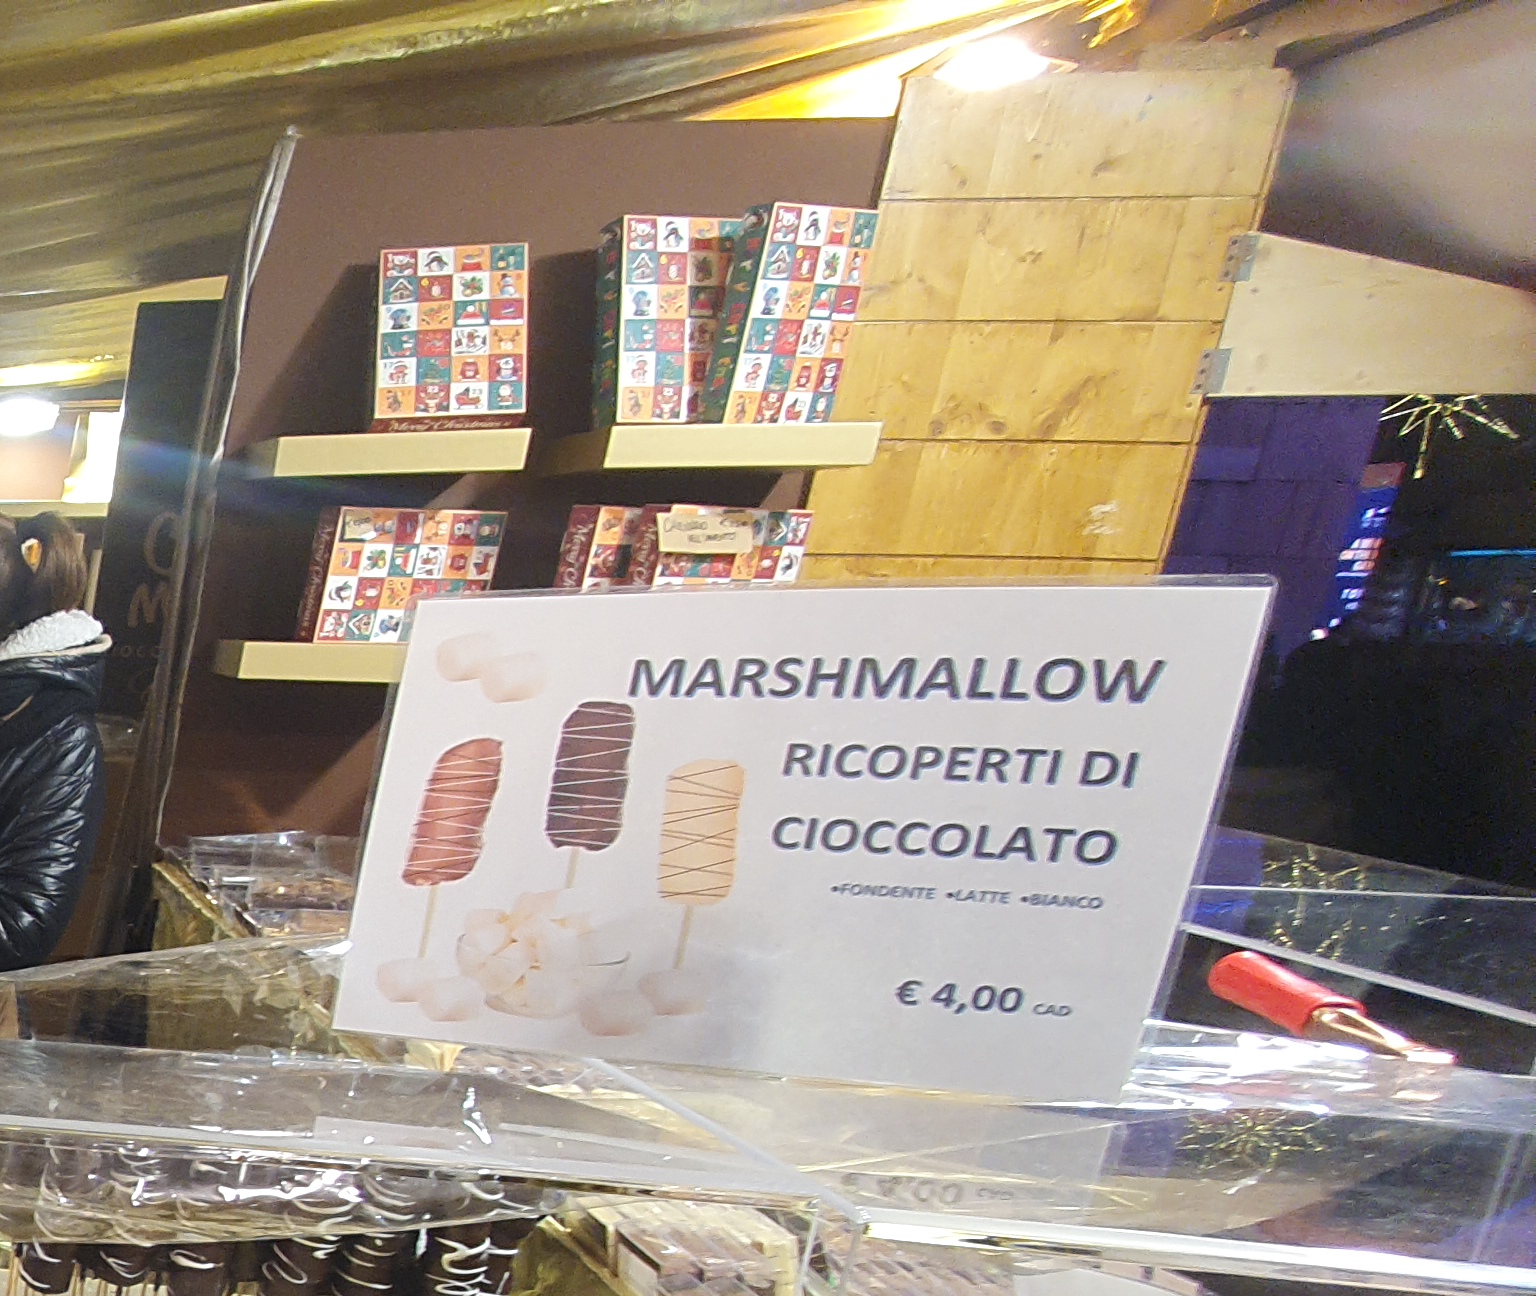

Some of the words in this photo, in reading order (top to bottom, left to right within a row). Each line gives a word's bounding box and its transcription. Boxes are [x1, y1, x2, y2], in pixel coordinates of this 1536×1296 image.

[628, 656, 1167, 704] MARSHMALLOW
[781, 742, 1062, 785] RICOPERTI
[1078, 749, 1141, 789] DI
[771, 816, 1120, 866] CIOCCOLATO
[896, 979, 924, 1006] €
[930, 982, 1024, 1015] 4,00
[1032, 1002, 1073, 1017] CAD
